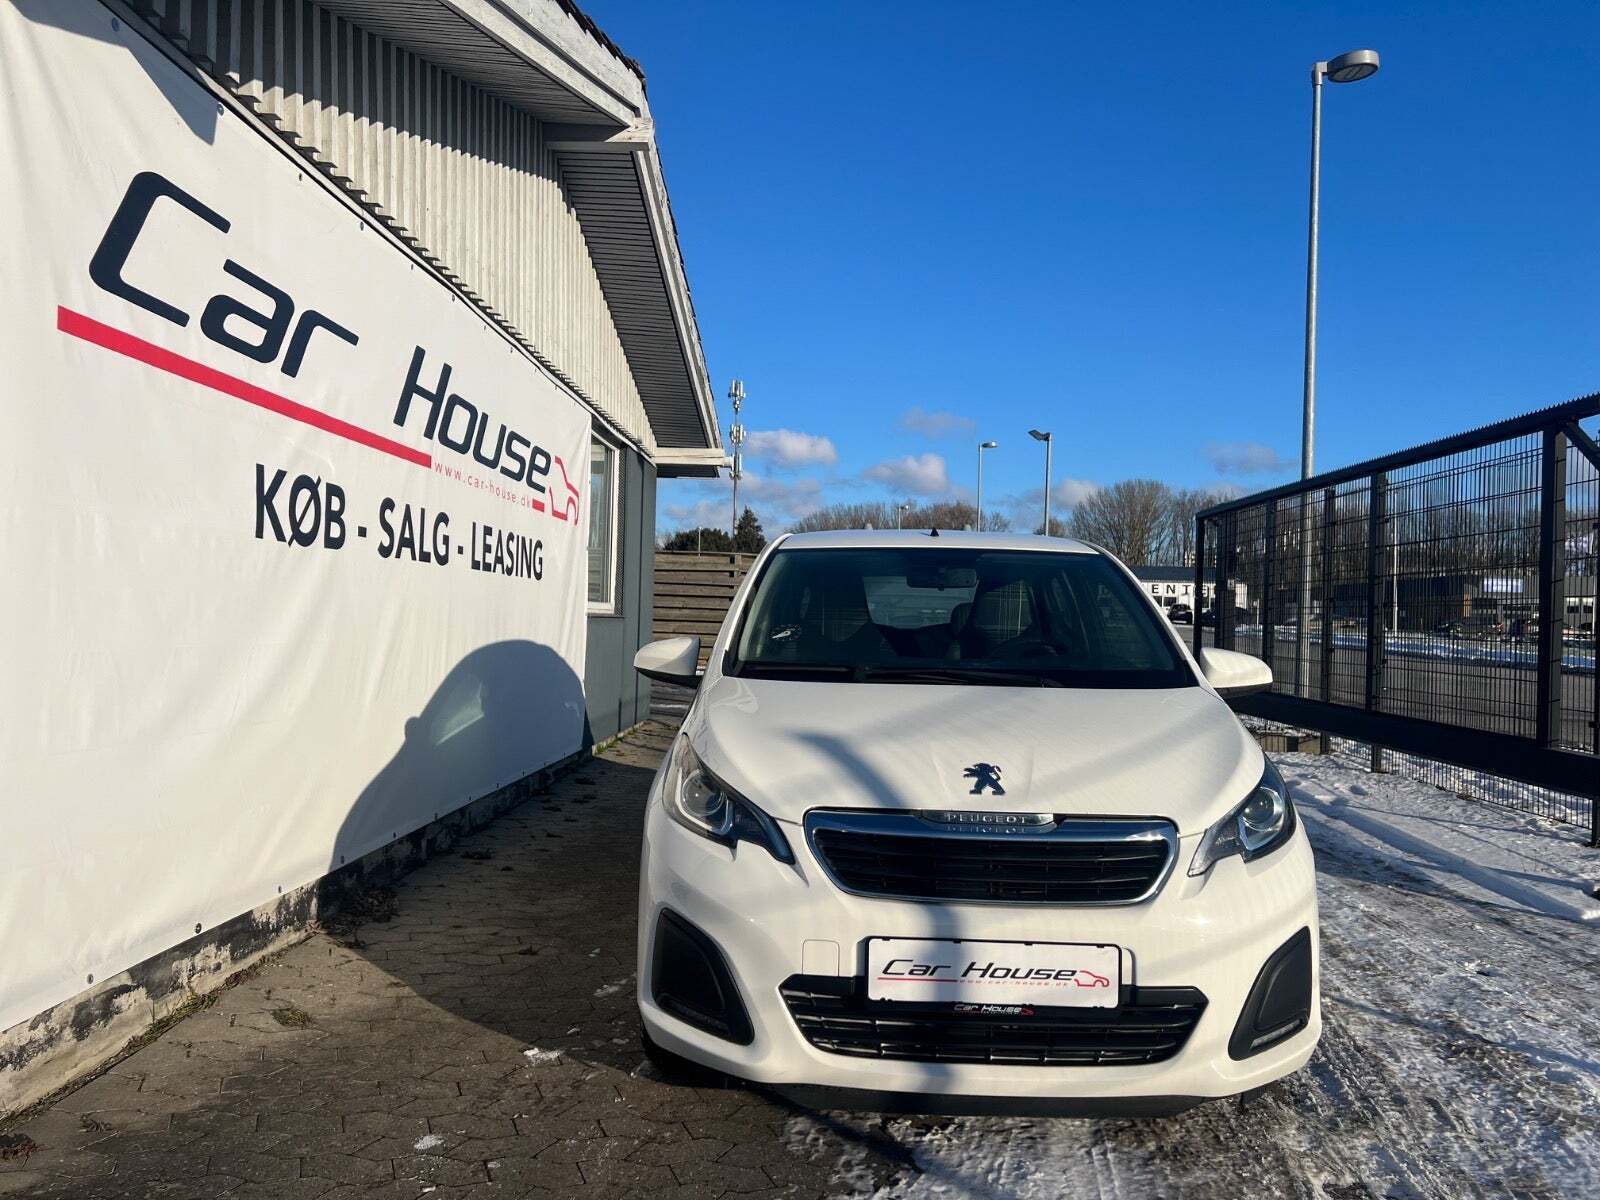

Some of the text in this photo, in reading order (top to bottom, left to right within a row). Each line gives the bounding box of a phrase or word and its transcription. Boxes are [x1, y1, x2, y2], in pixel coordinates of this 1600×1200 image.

[89, 171, 552, 494] Car House
[434, 462, 530, 507] www.car-house.dk
[254, 462, 346, 549] KØB
[378, 496, 450, 567] SALG
[471, 521, 543, 581] LEASING
[944, 812, 1025, 824] PEUGEOT
[882, 959, 1077, 981] Car House
[953, 1003, 1022, 1014] Car House
